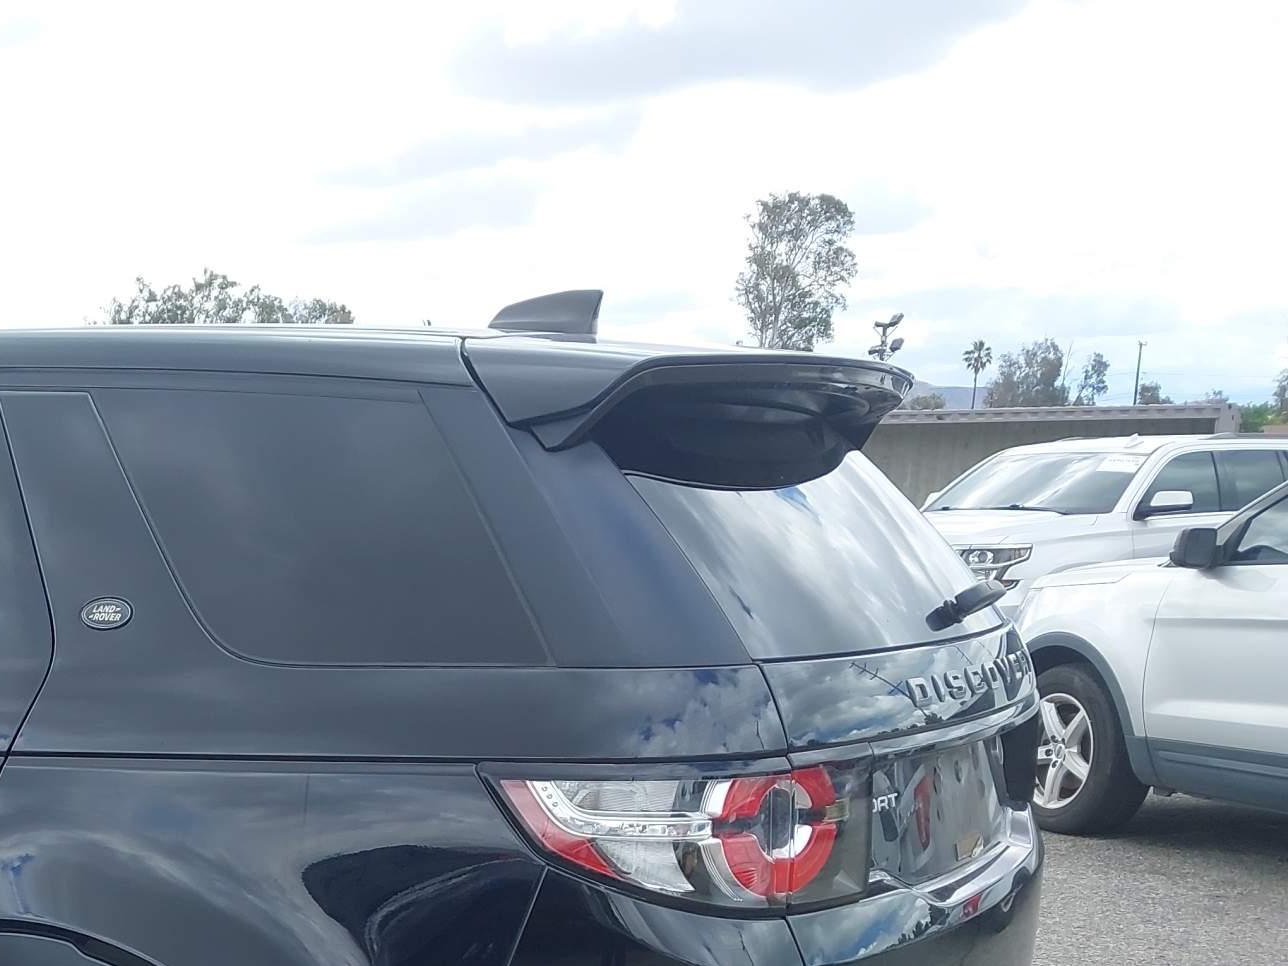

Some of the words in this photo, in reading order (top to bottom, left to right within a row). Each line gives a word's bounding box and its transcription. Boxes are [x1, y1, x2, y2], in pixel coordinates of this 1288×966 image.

[92, 604, 117, 613] LAND
[92, 612, 122, 621] ROVER
[905, 650, 1032, 707] DISCOVER
